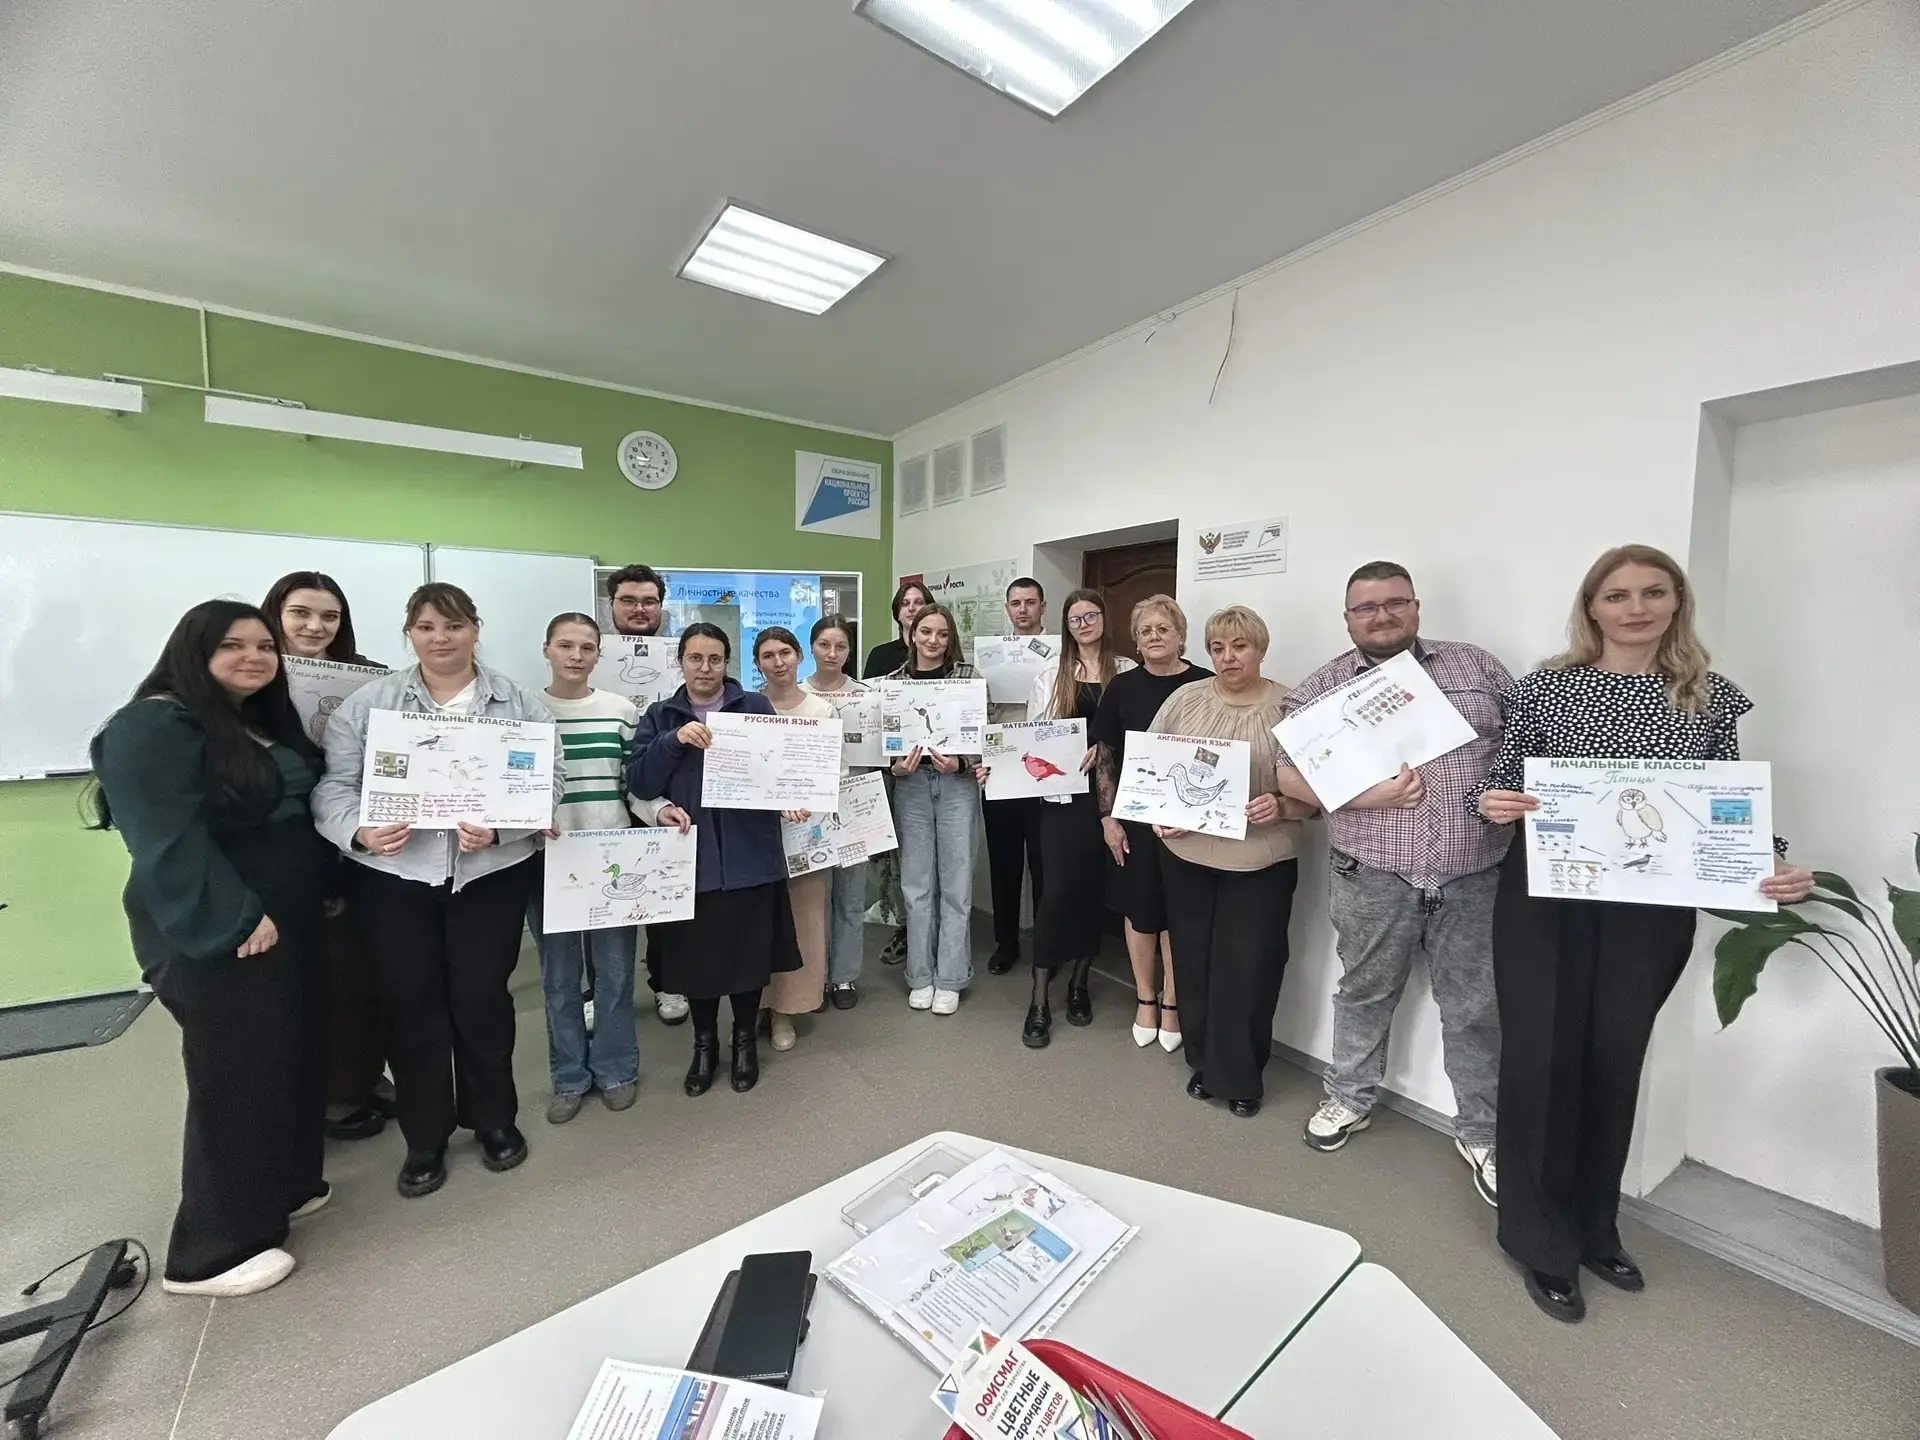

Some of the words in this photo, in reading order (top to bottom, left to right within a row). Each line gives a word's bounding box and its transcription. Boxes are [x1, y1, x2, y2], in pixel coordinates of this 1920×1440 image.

[824, 478, 869, 492] НАЦИОНАЛЬНЫЕ
[843, 488, 869, 499] ПРОЕКТЫ
[847, 496, 869, 506] РОССИИ
[677, 587, 736, 598] Личностные
[738, 588, 779, 599] качества
[621, 635, 644, 643] ТРУД
[1290, 699, 1320, 720] ИСТОРИЯ
[1320, 666, 1384, 701] ОБЩЕСТВОЗНАНИЕ
[402, 712, 475, 724] НАЧАЛЬНЫЕ
[477, 717, 522, 728] КЛАССЫ
[744, 715, 789, 725] РУССКИЙ
[791, 718, 819, 726] ЯЗЫК
[1002, 720, 1054, 729] МАТЕМАТИКА
[1157, 734, 1207, 745] АНГЛИЙСКИЙ
[1209, 740, 1232, 748] ЯЗЫК
[1550, 759, 1639, 770] НАЧАЛЬНЫЕ
[1643, 760, 1706, 771] КЛАССЫ
[839, 776, 866, 786] КЛАССЫ
[568, 829, 626, 838] ФИЗИЧЕСКАЯ
[627, 828, 669, 836] КУЛЬТУРА
[975, 1350, 1019, 1417] ОФИСМАГ
[996, 1369, 1041, 1436] ЦВЕТНЫЕ
[1035, 1424, 1047, 1438] 12
[1042, 1391, 1063, 1426] ЦВЕТОВ
